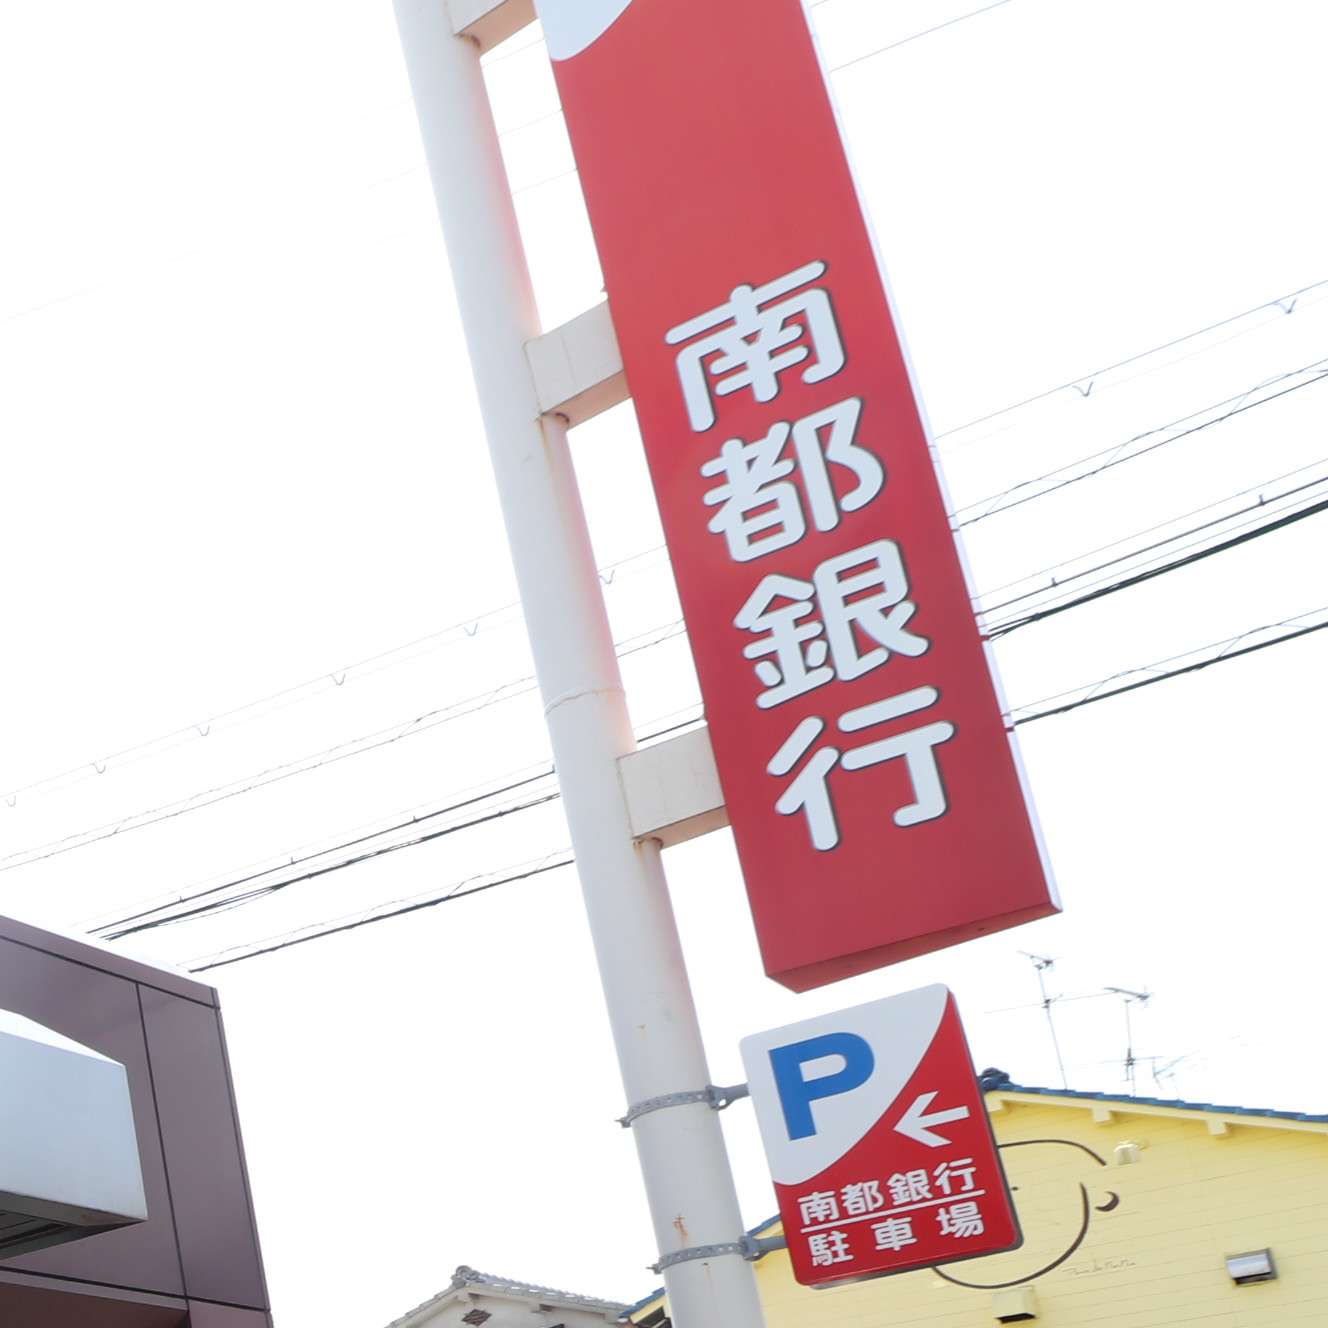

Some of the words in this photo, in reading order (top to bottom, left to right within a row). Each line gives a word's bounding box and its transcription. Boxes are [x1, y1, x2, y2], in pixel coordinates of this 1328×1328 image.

[664, 259, 954, 852] 南都銀行
[768, 1031, 875, 1141] P
[797, 1157, 977, 1227] 南都銀行
[808, 1201, 985, 1267] 駐車場
